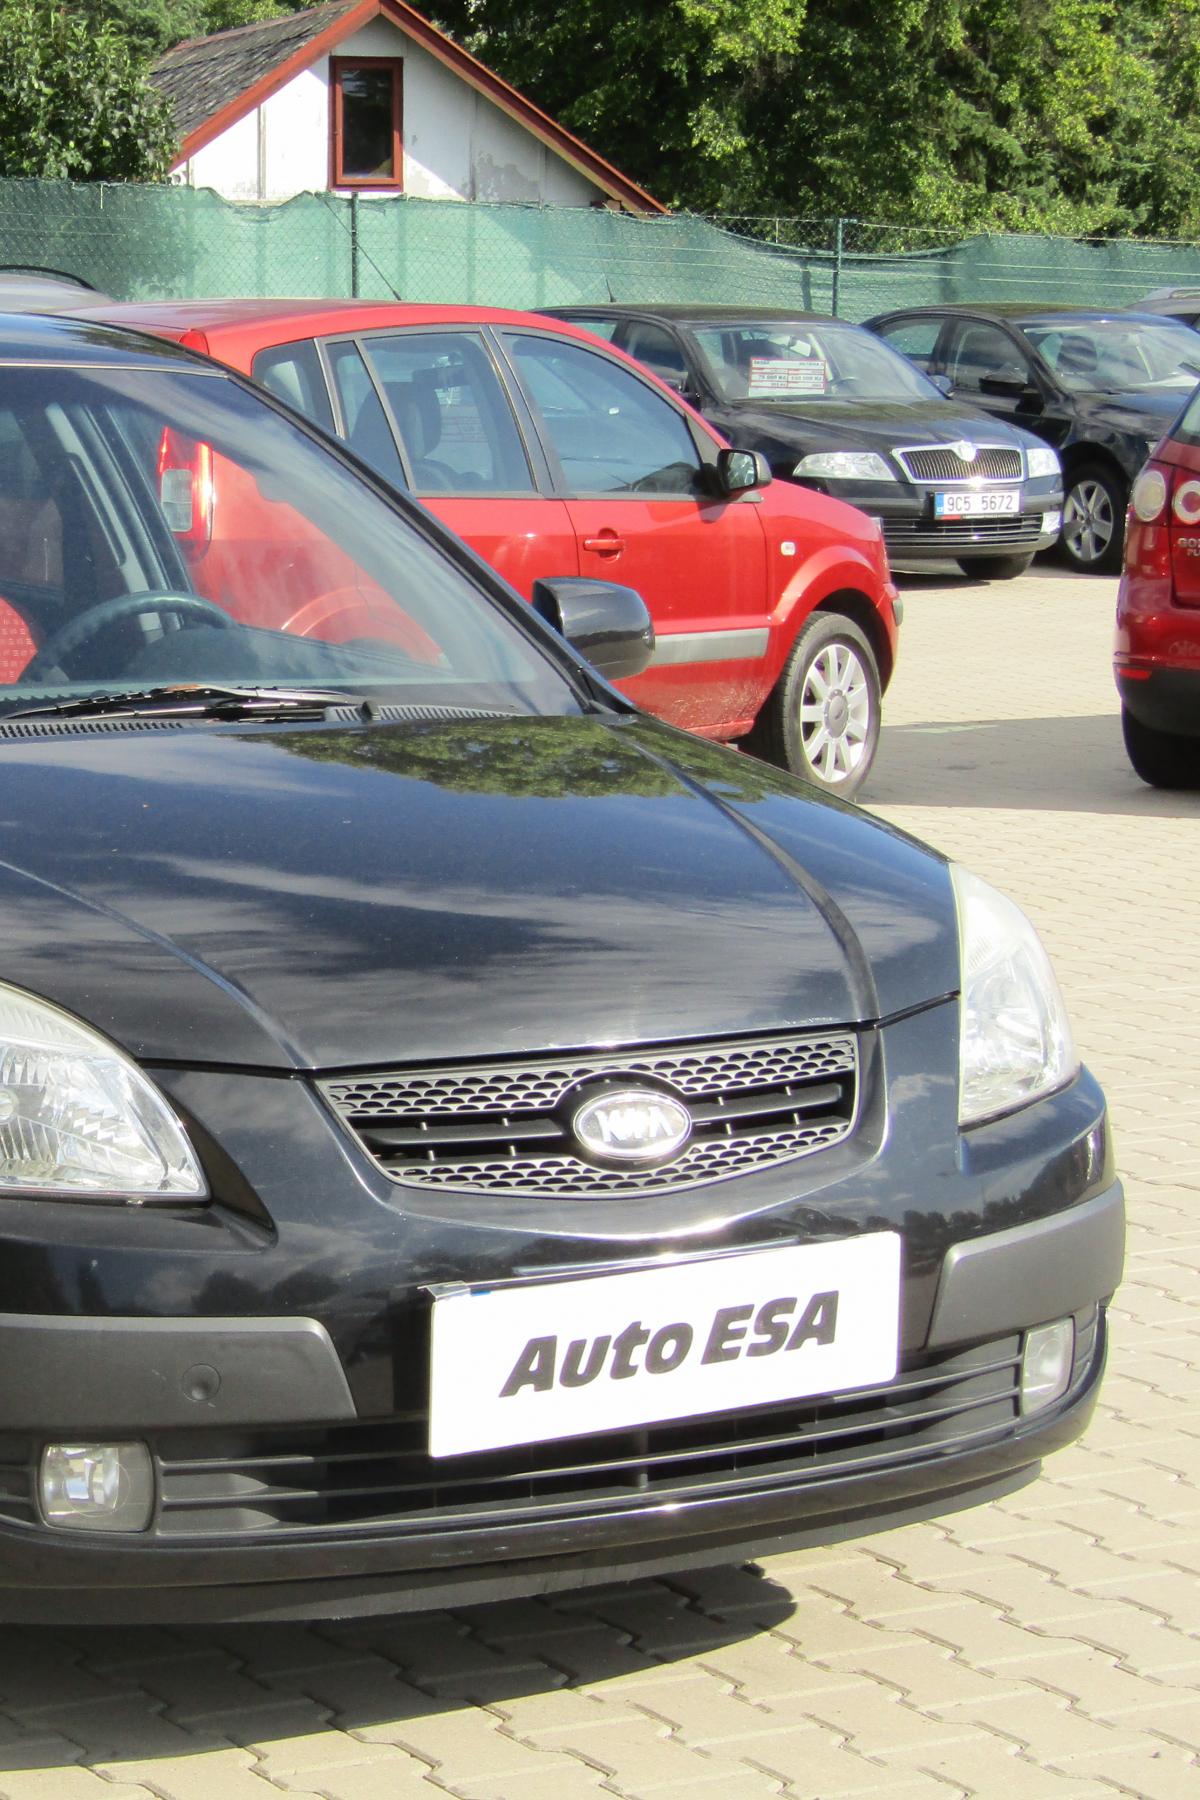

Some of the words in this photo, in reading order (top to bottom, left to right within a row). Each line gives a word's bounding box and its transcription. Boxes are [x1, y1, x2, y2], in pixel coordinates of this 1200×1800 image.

[947, 496, 971, 512] 9C5
[981, 495, 1013, 510] 5672
[1177, 537, 1200, 548] GO
[499, 1321, 694, 1398] Auto
[700, 1290, 840, 1365] ESA
